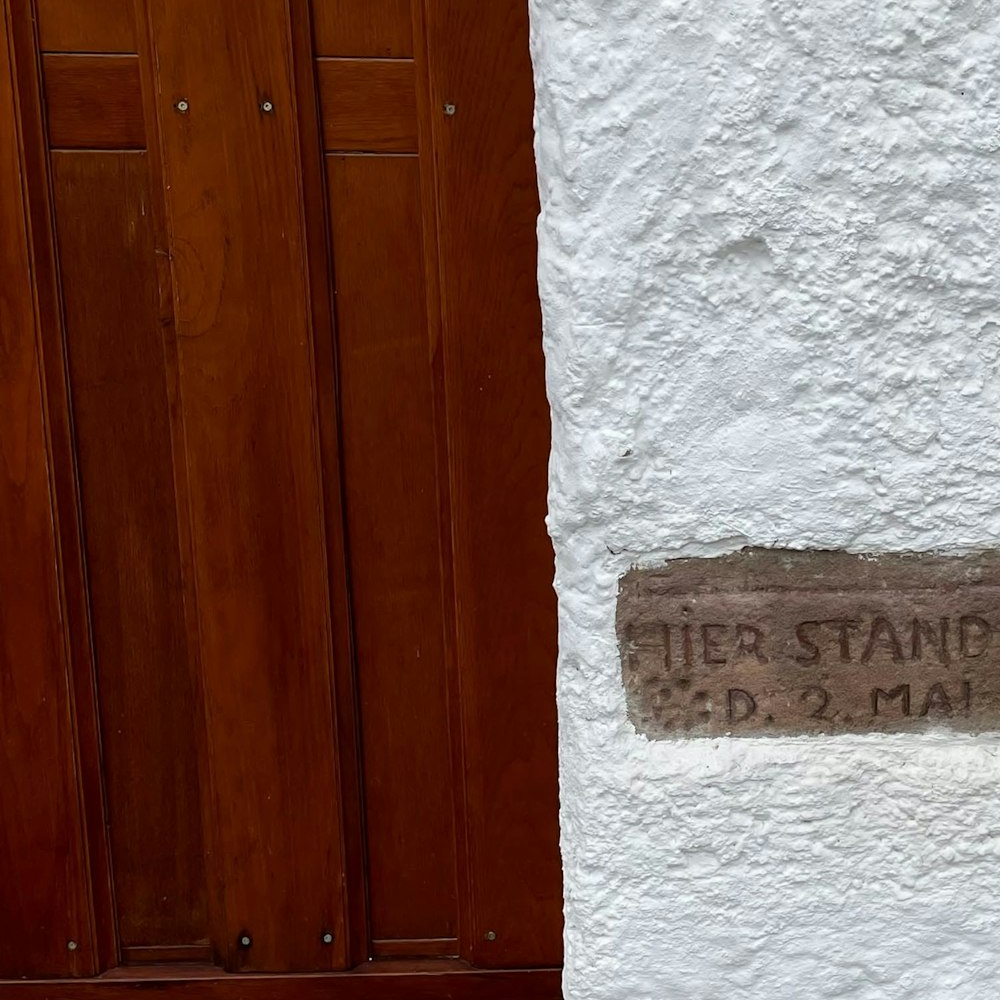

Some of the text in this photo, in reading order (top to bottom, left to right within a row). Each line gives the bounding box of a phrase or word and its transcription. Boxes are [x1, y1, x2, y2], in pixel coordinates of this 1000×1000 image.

[625, 620, 769, 671] HIER
[796, 614, 993, 668] STAND
[871, 684, 971, 719] MAI
